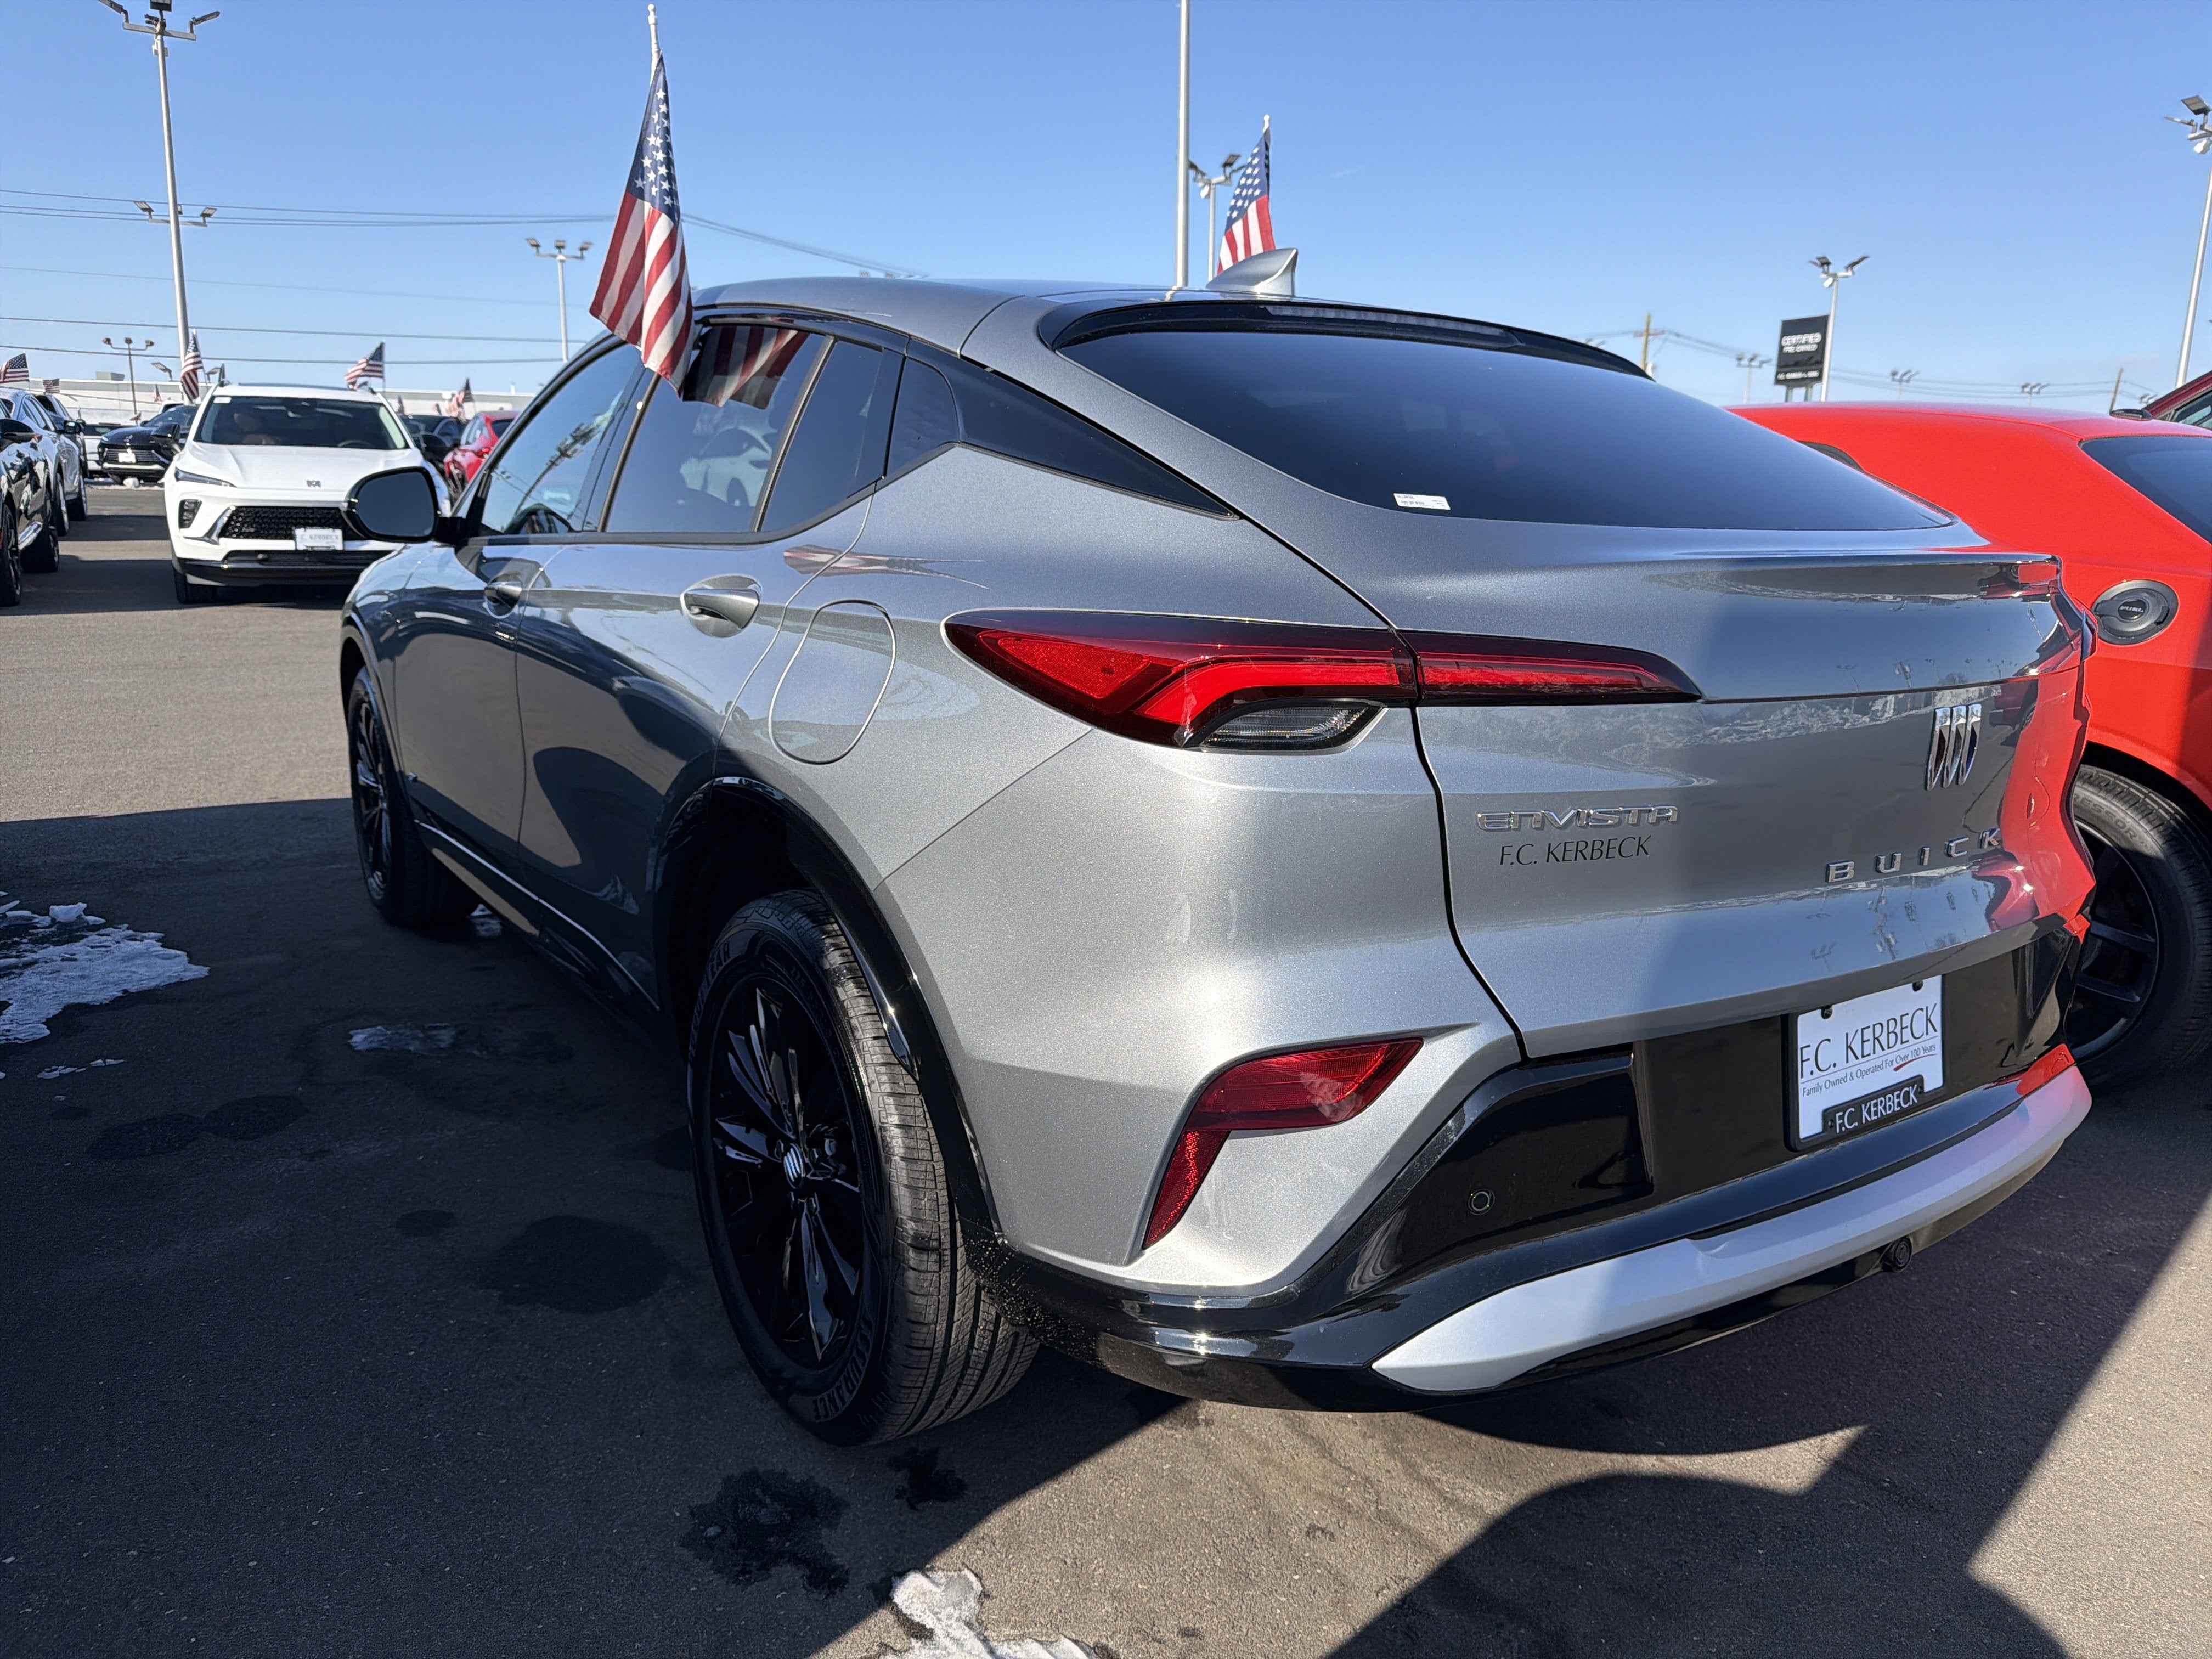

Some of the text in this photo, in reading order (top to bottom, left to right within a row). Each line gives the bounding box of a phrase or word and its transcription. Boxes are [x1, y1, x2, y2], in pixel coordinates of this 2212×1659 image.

[1477, 805, 1678, 830] ENVISTA
[1500, 835, 1652, 866] F.C. KERBECK
[1826, 828, 2000, 883] BUICK
[1800, 1003, 1938, 1079] F.C. KERBECK
[1802, 1044, 1936, 1097] Family Owned & Operated For Over 100 Years
[1836, 1084, 1918, 1133] F.C. KERBECK
